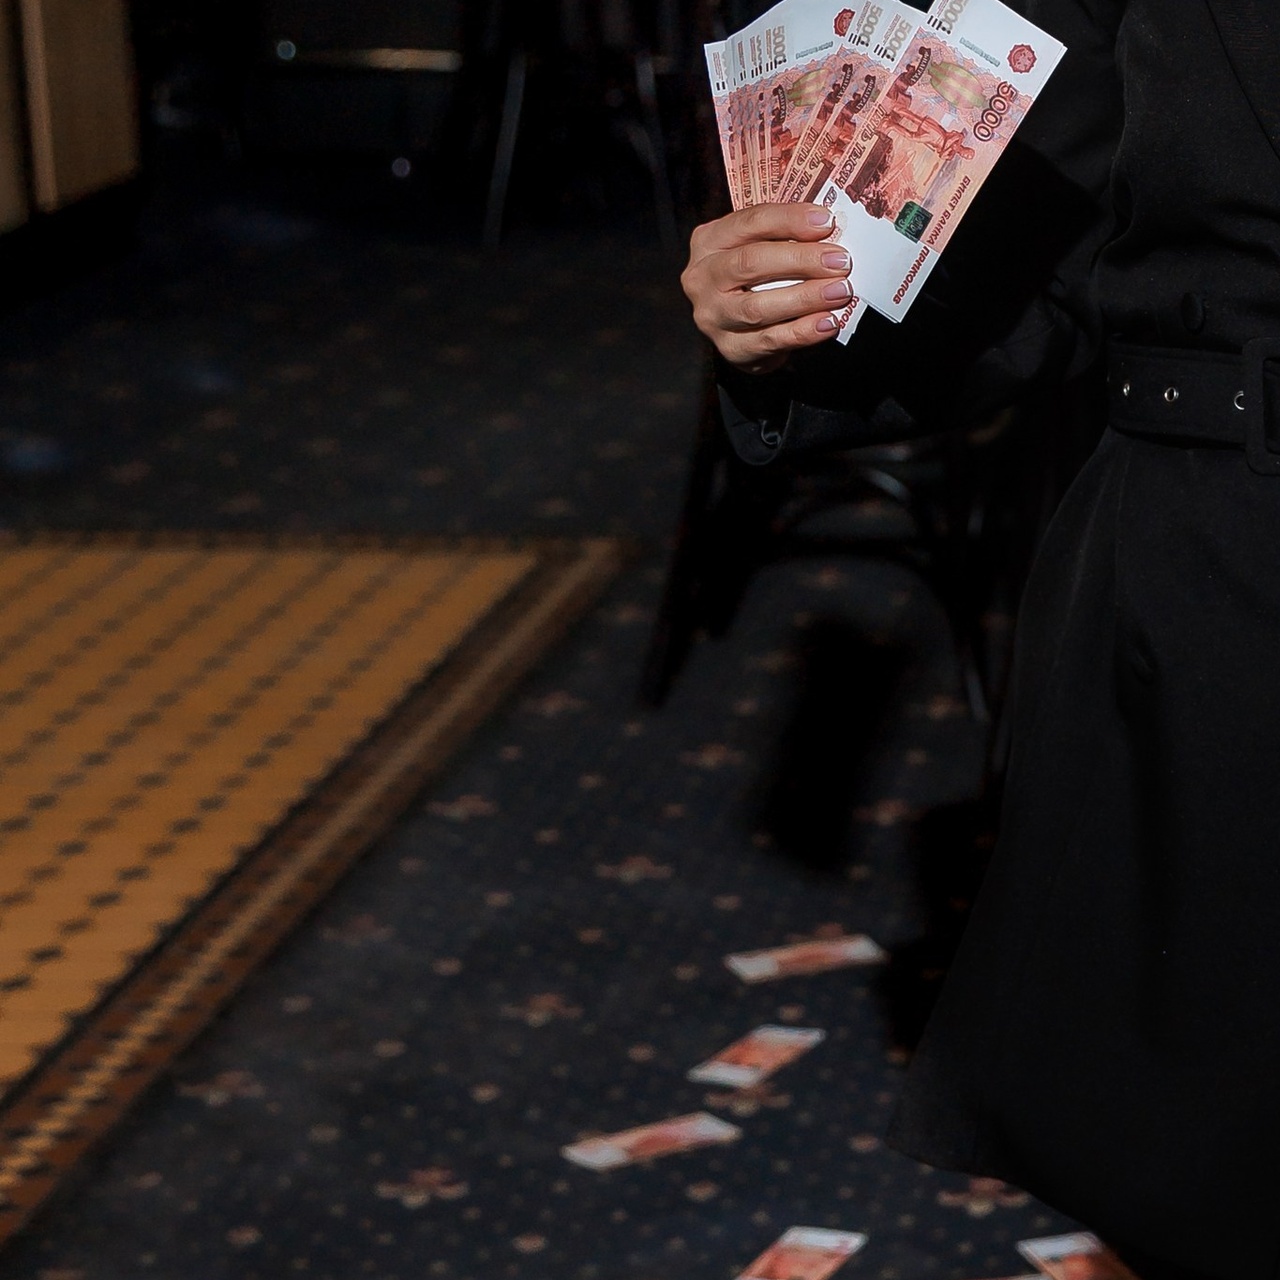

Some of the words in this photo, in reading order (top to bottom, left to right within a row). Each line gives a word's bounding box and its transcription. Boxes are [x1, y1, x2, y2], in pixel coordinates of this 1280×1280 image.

[861, 104, 888, 142] ПЯТЬ
[973, 80, 1018, 142] 5000
[835, 144, 866, 190] ТЫСЯЧ
[950, 175, 972, 212] БИЛЕТ
[926, 210, 951, 246] БАНКА
[893, 245, 930, 305] ПРИКОЛОВ
